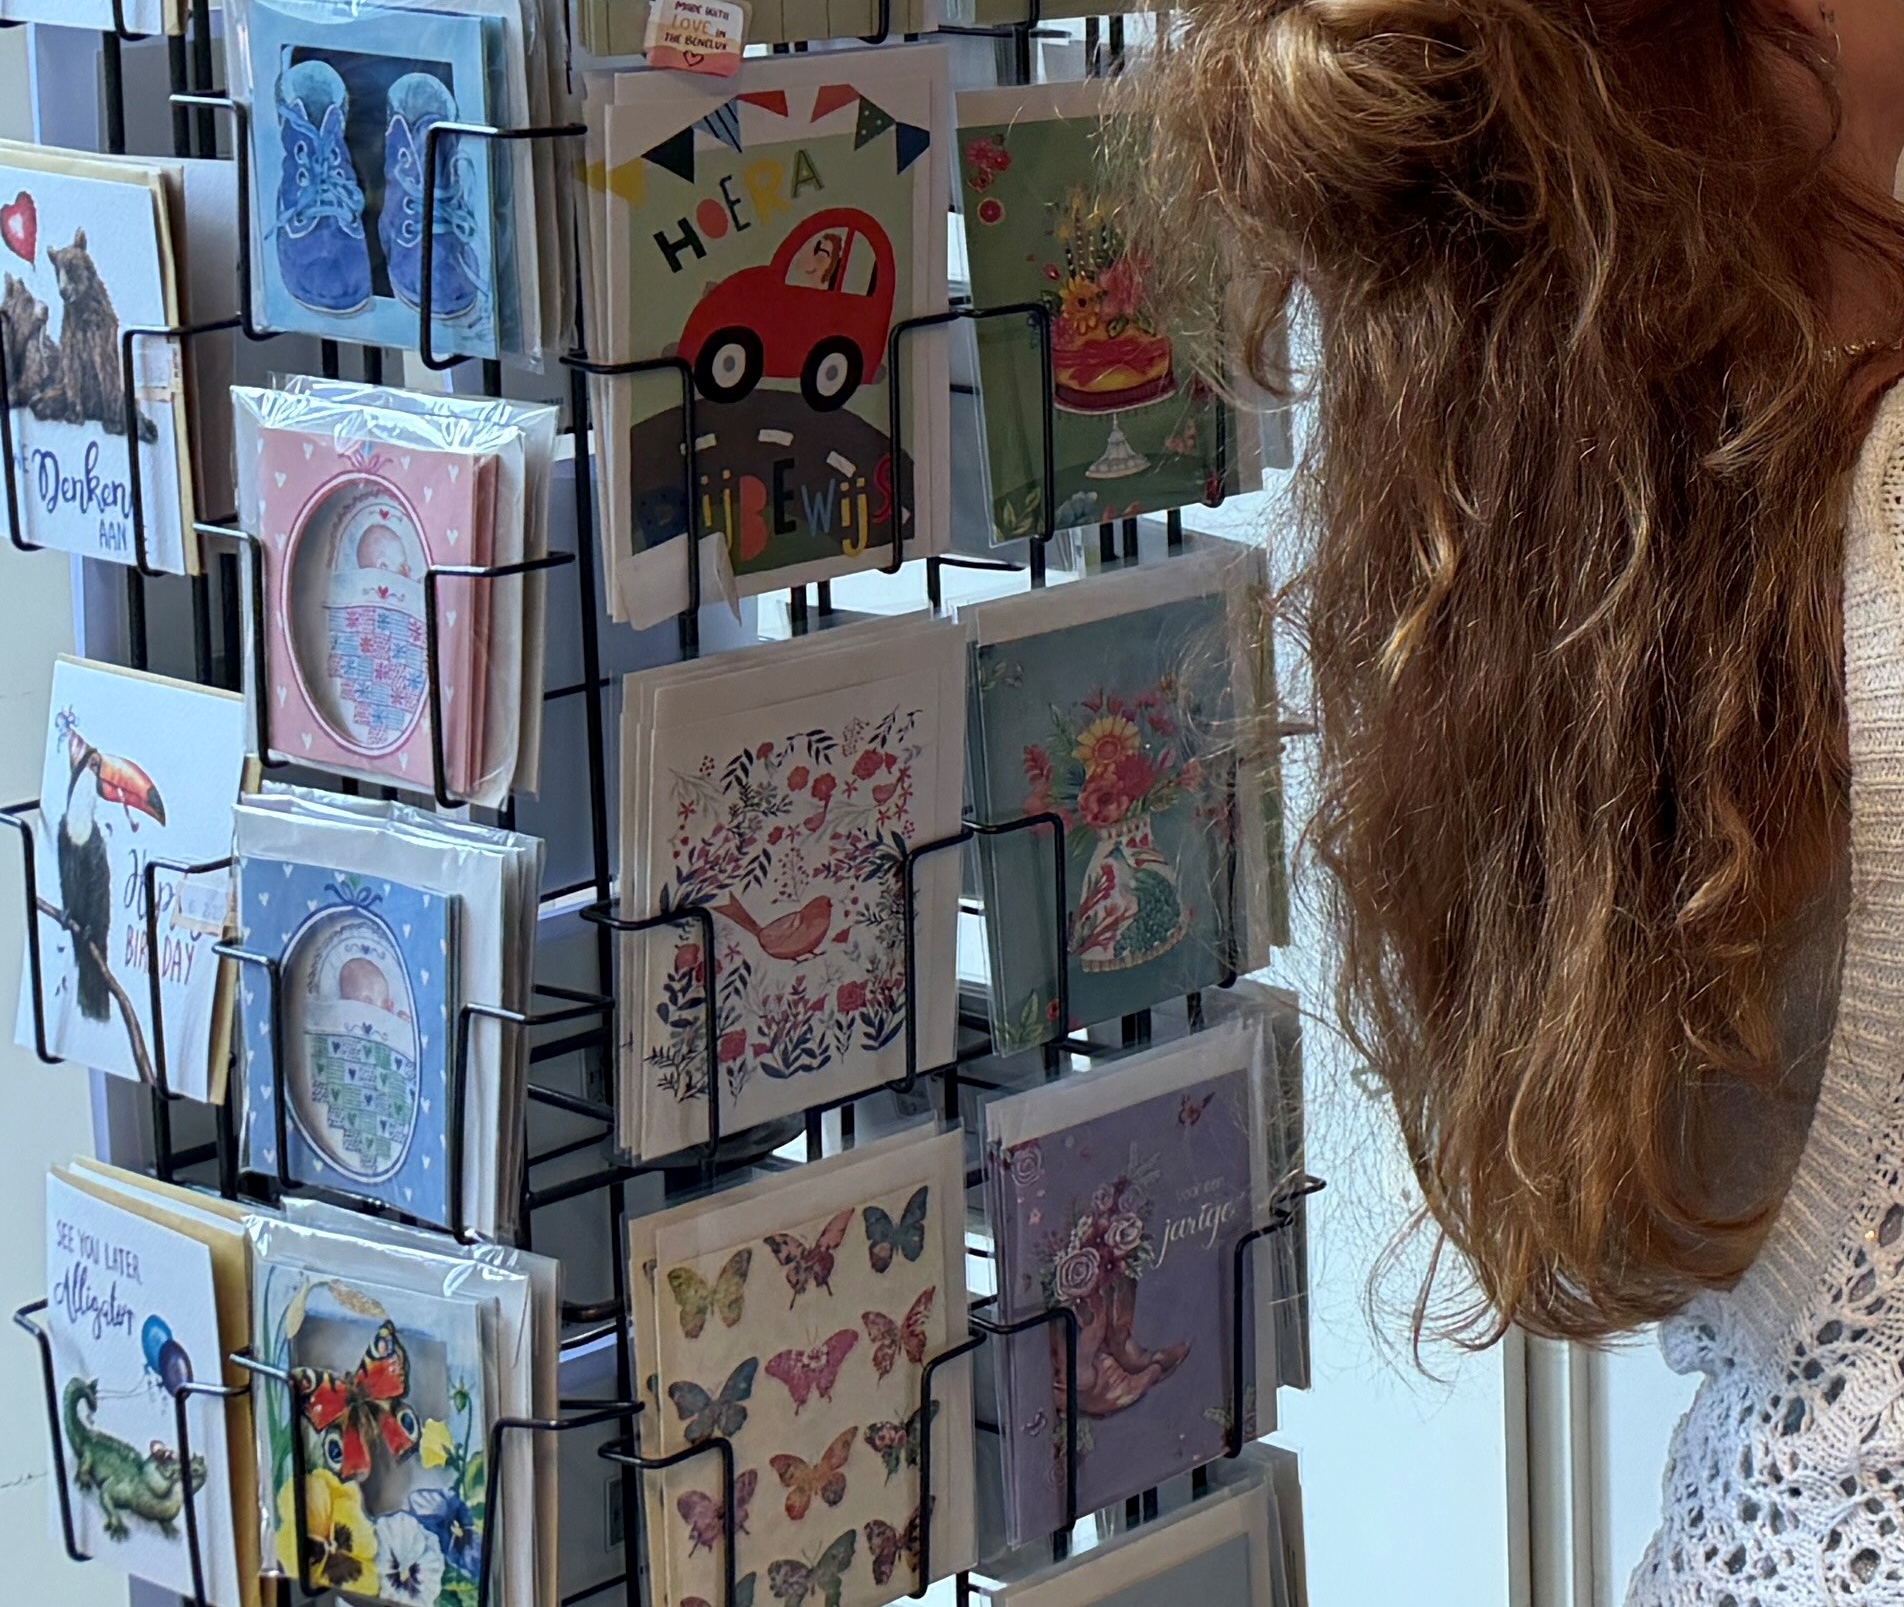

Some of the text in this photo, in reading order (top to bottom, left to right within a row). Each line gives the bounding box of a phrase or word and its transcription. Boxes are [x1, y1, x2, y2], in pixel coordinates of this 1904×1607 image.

[671, 14, 712, 35] LOVE
[653, 149, 825, 274] HOERA
[32, 441, 133, 519] Denken
[100, 519, 127, 551] AAN
[1151, 1201, 1236, 1270] jarige
